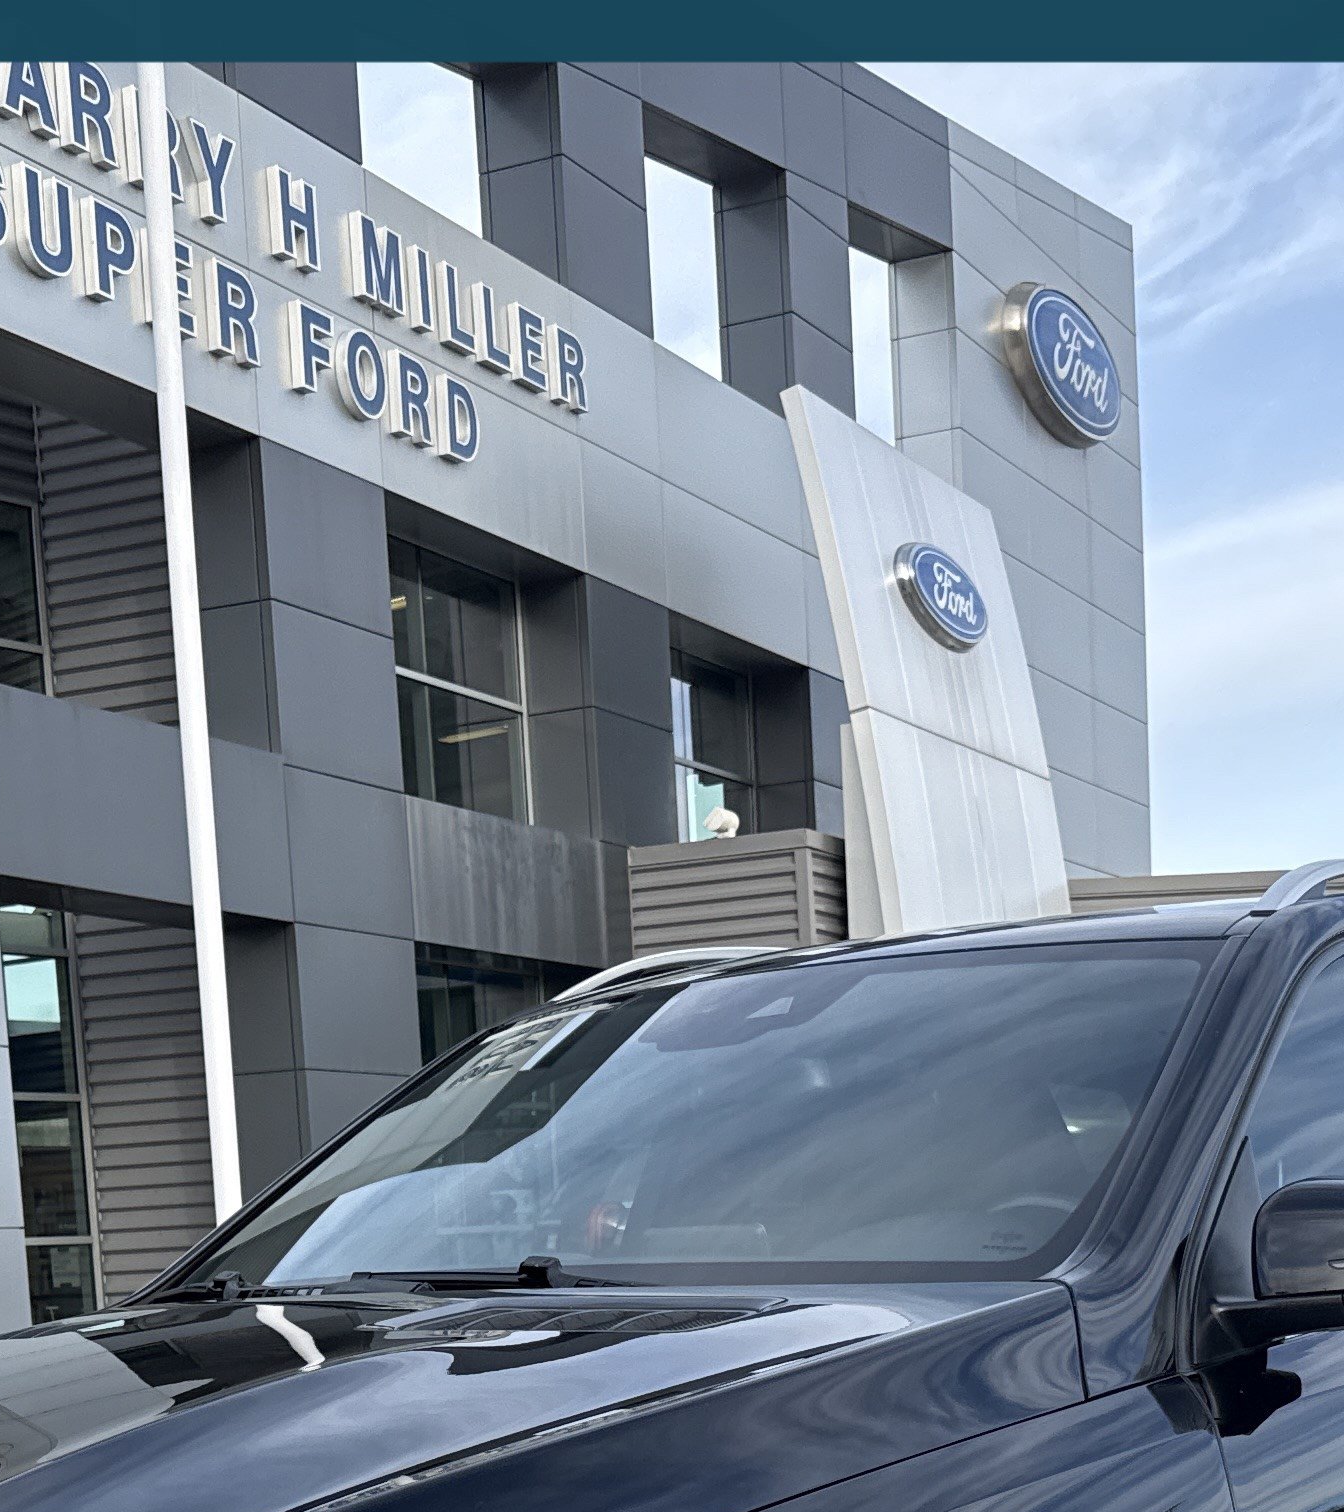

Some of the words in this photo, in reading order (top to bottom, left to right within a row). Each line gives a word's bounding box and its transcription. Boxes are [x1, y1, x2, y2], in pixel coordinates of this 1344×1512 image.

[270, 164, 321, 273] H
[352, 211, 588, 414] MILLER
[286, 299, 481, 463] FORD
[1053, 312, 1110, 413] Ford
[933, 561, 977, 626] Ford
